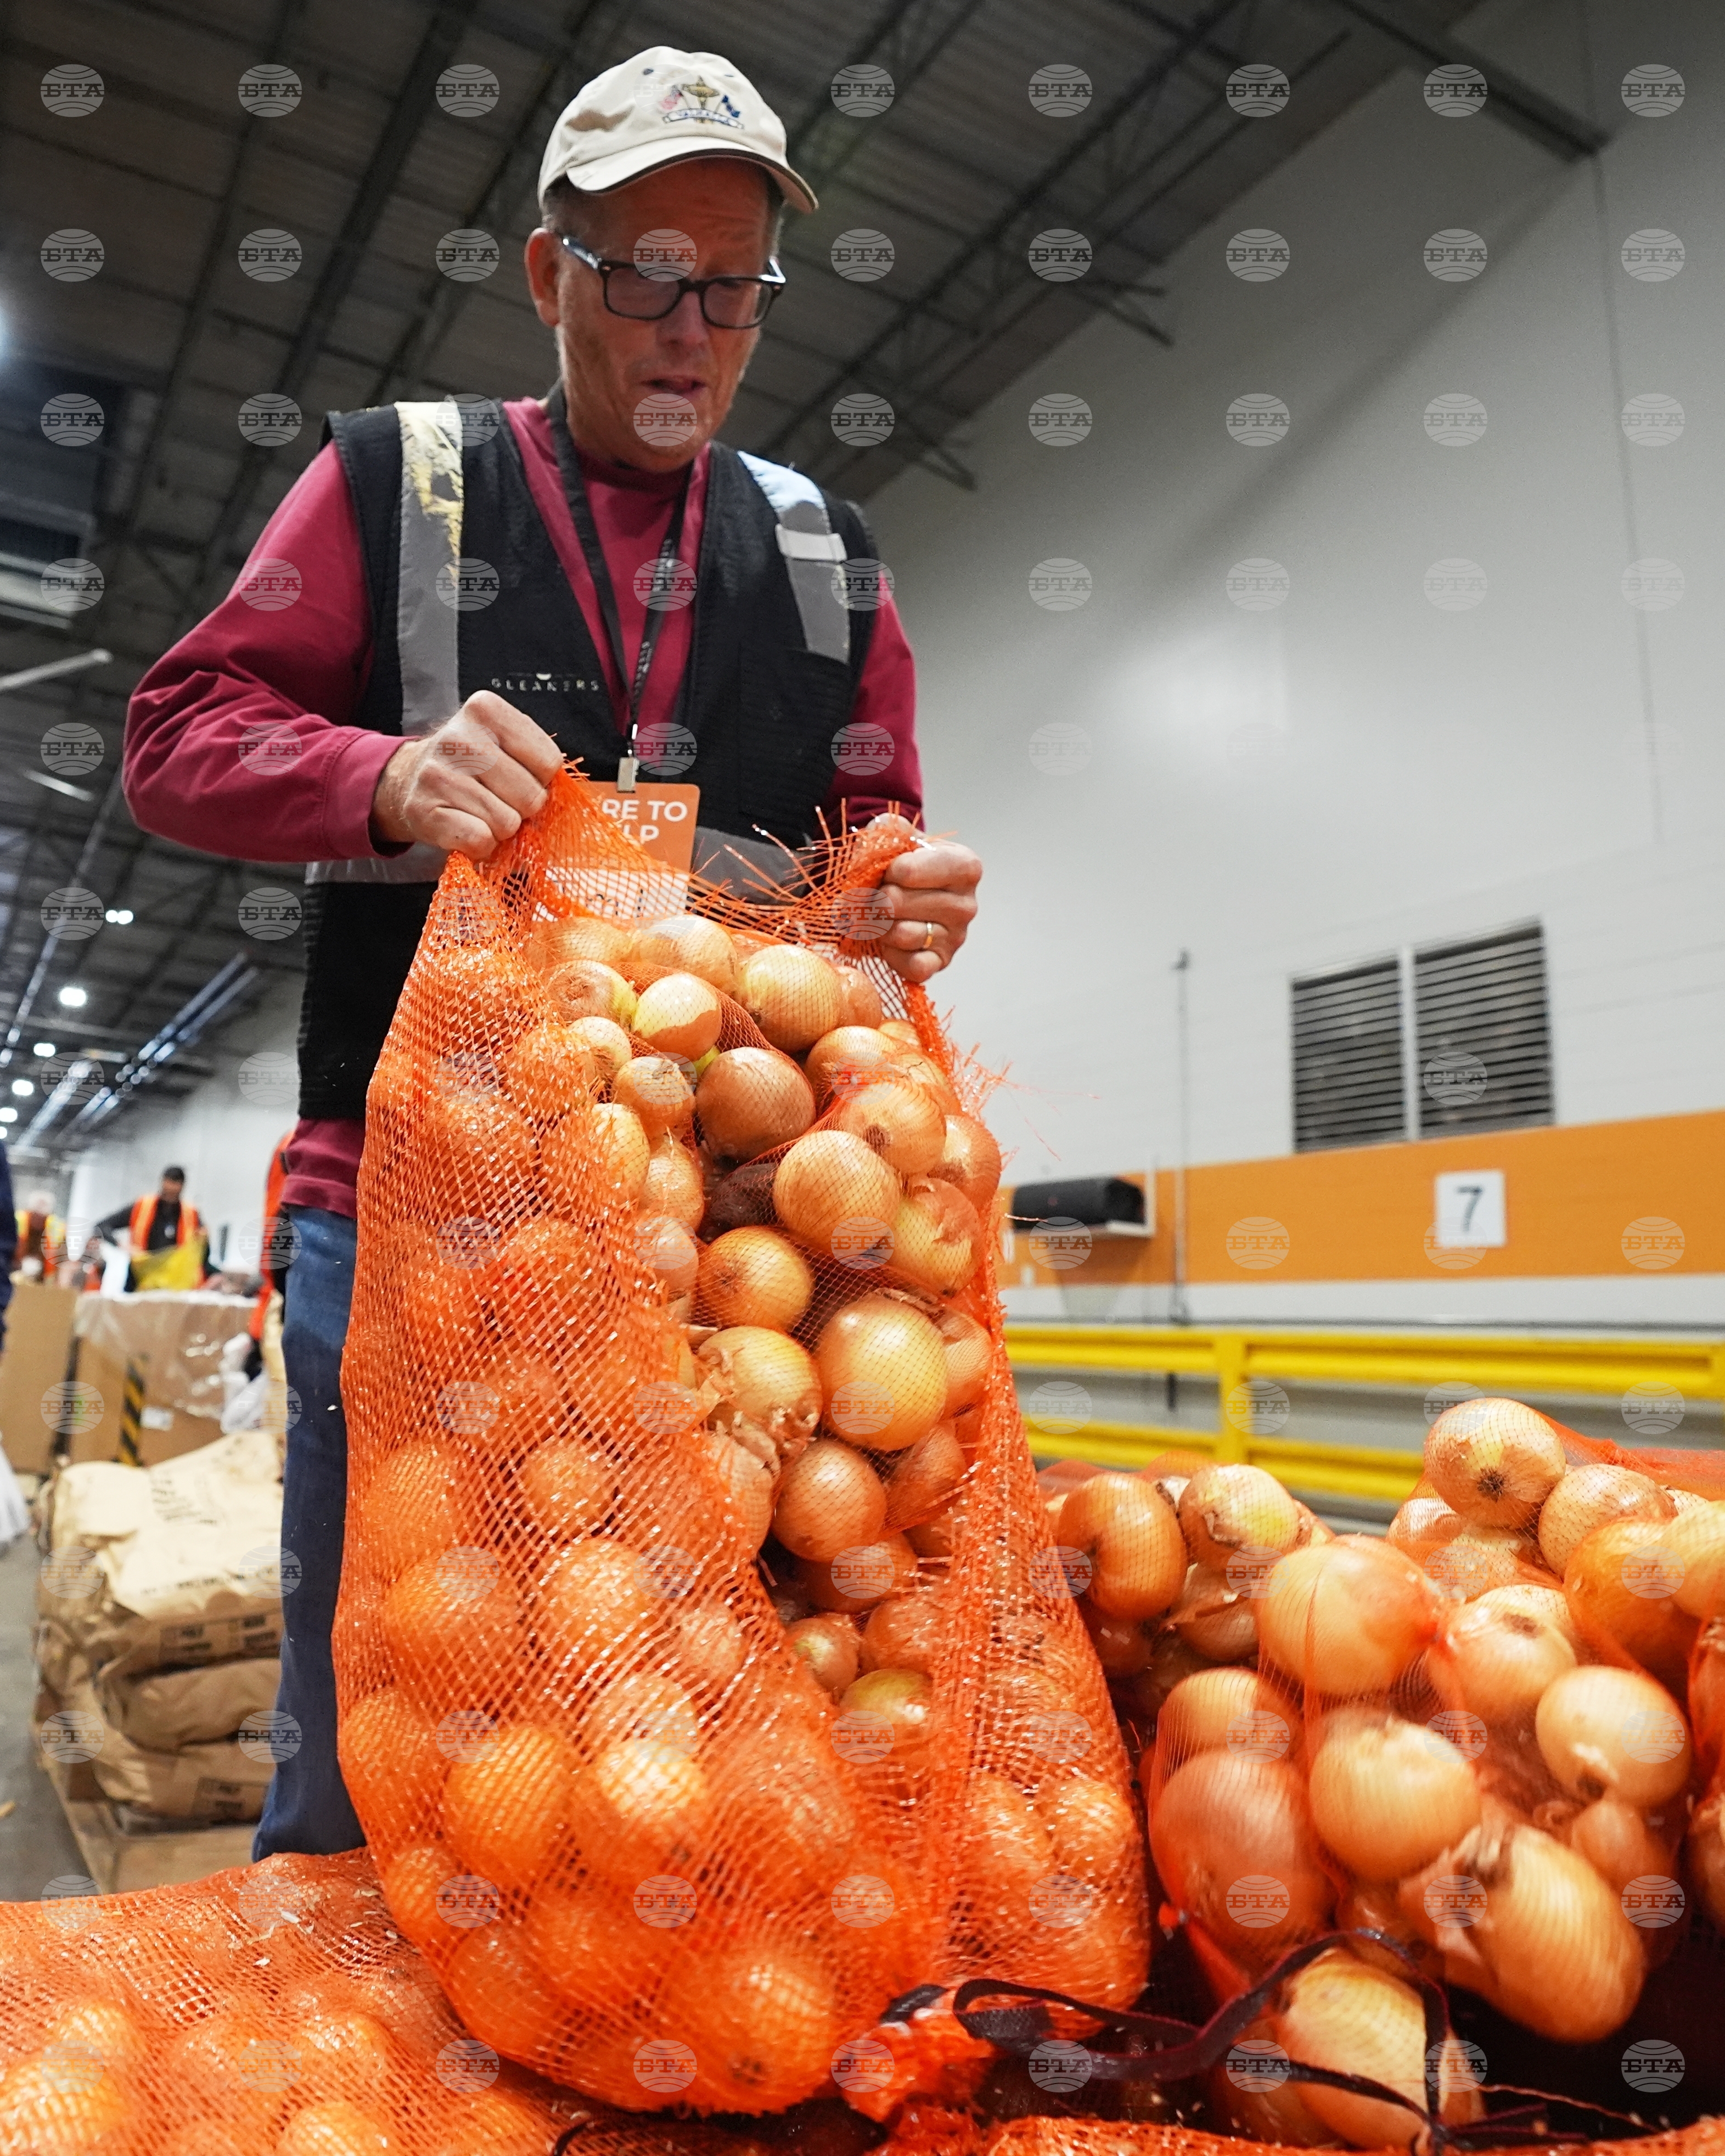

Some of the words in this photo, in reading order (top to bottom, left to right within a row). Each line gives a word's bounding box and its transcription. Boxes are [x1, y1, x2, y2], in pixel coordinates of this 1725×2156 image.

[602, 798, 640, 820] RE
[647, 800, 688, 822] TO
[1457, 1186, 1483, 1232] 7
